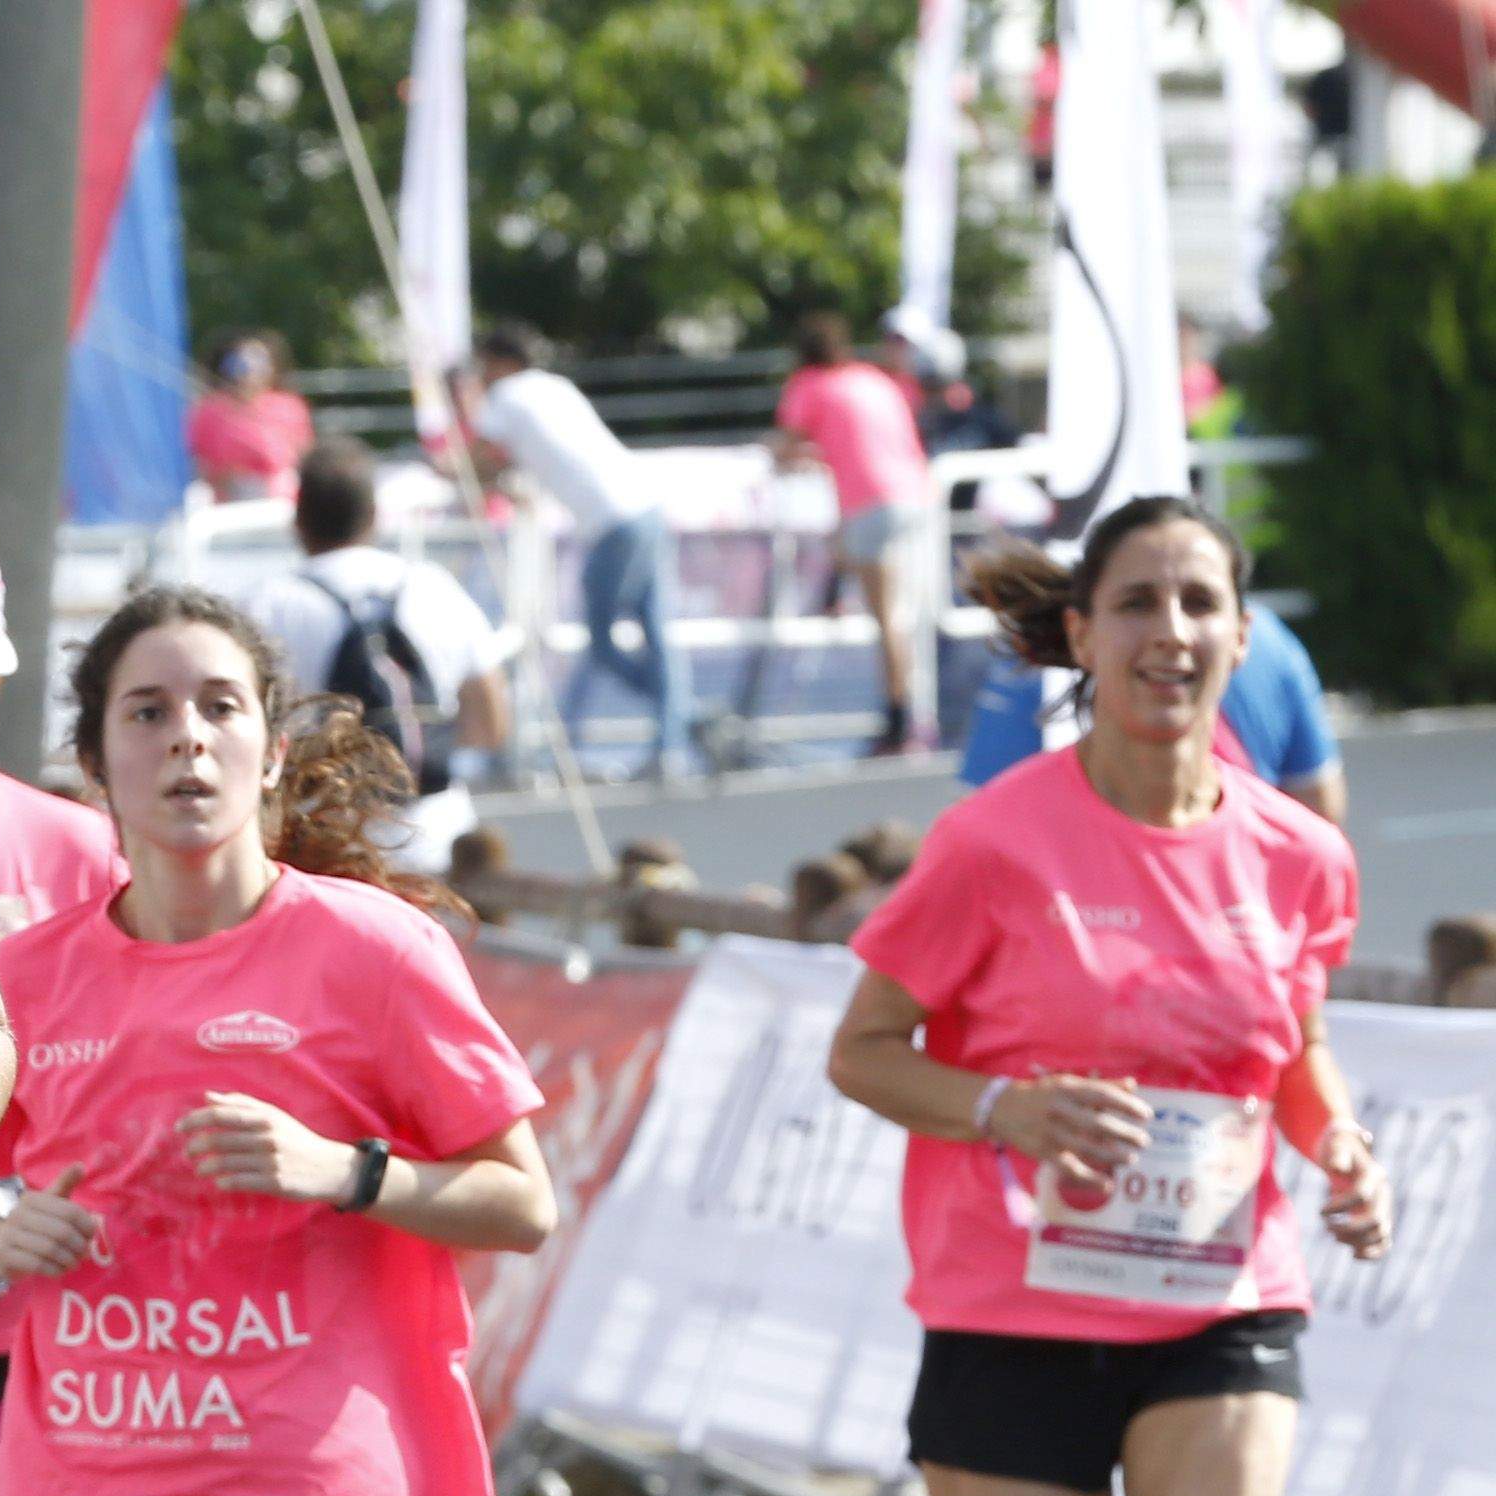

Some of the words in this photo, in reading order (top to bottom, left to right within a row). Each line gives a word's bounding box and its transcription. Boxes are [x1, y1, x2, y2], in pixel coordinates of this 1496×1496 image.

[27, 1036, 118, 1071] OYSH
[55, 1289, 311, 1357] DORSAL
[47, 1368, 245, 1429] SUMA
